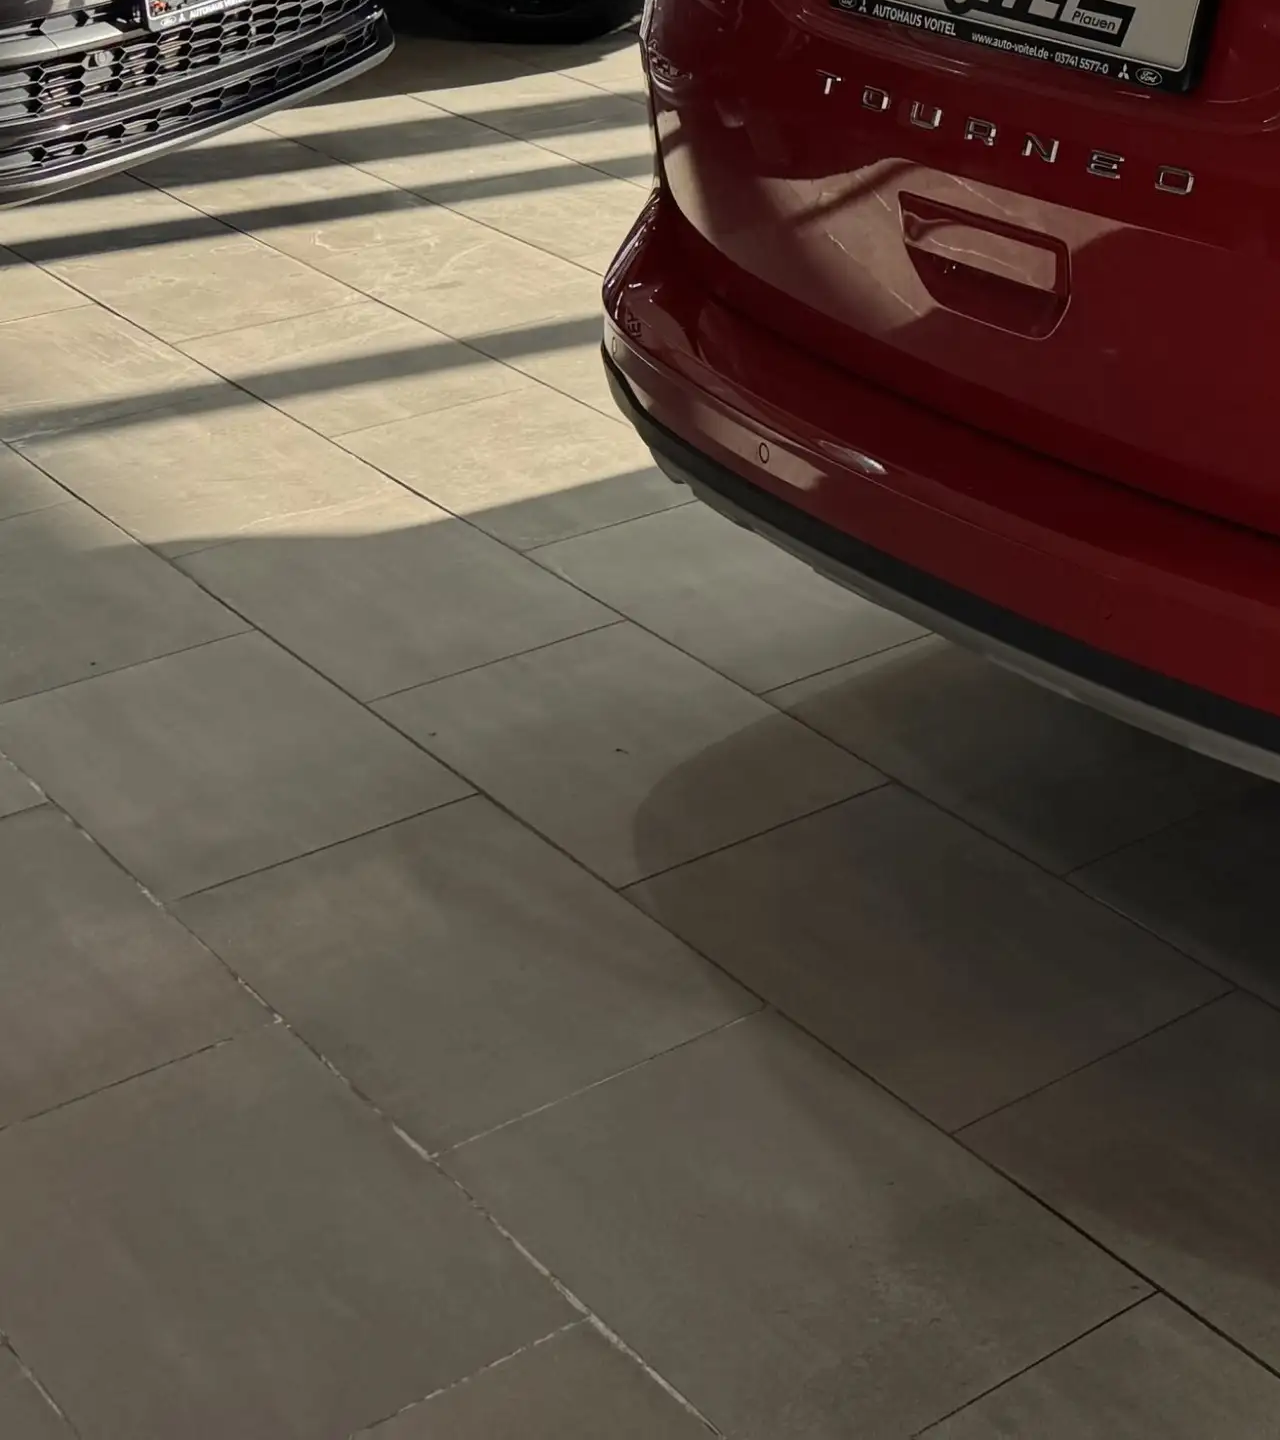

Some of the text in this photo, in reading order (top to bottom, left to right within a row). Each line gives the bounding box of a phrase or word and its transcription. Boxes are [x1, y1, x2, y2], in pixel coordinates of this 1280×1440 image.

[872, 3, 957, 37] AUTOHAUS VOITEL
[1070, 10, 1118, 32] Plauen
[971, 30, 1110, 75] www.auto-voitel.de 03741 5577-0
[1138, 69, 1160, 84] Ford
[815, 68, 1195, 196] TOURNEO
